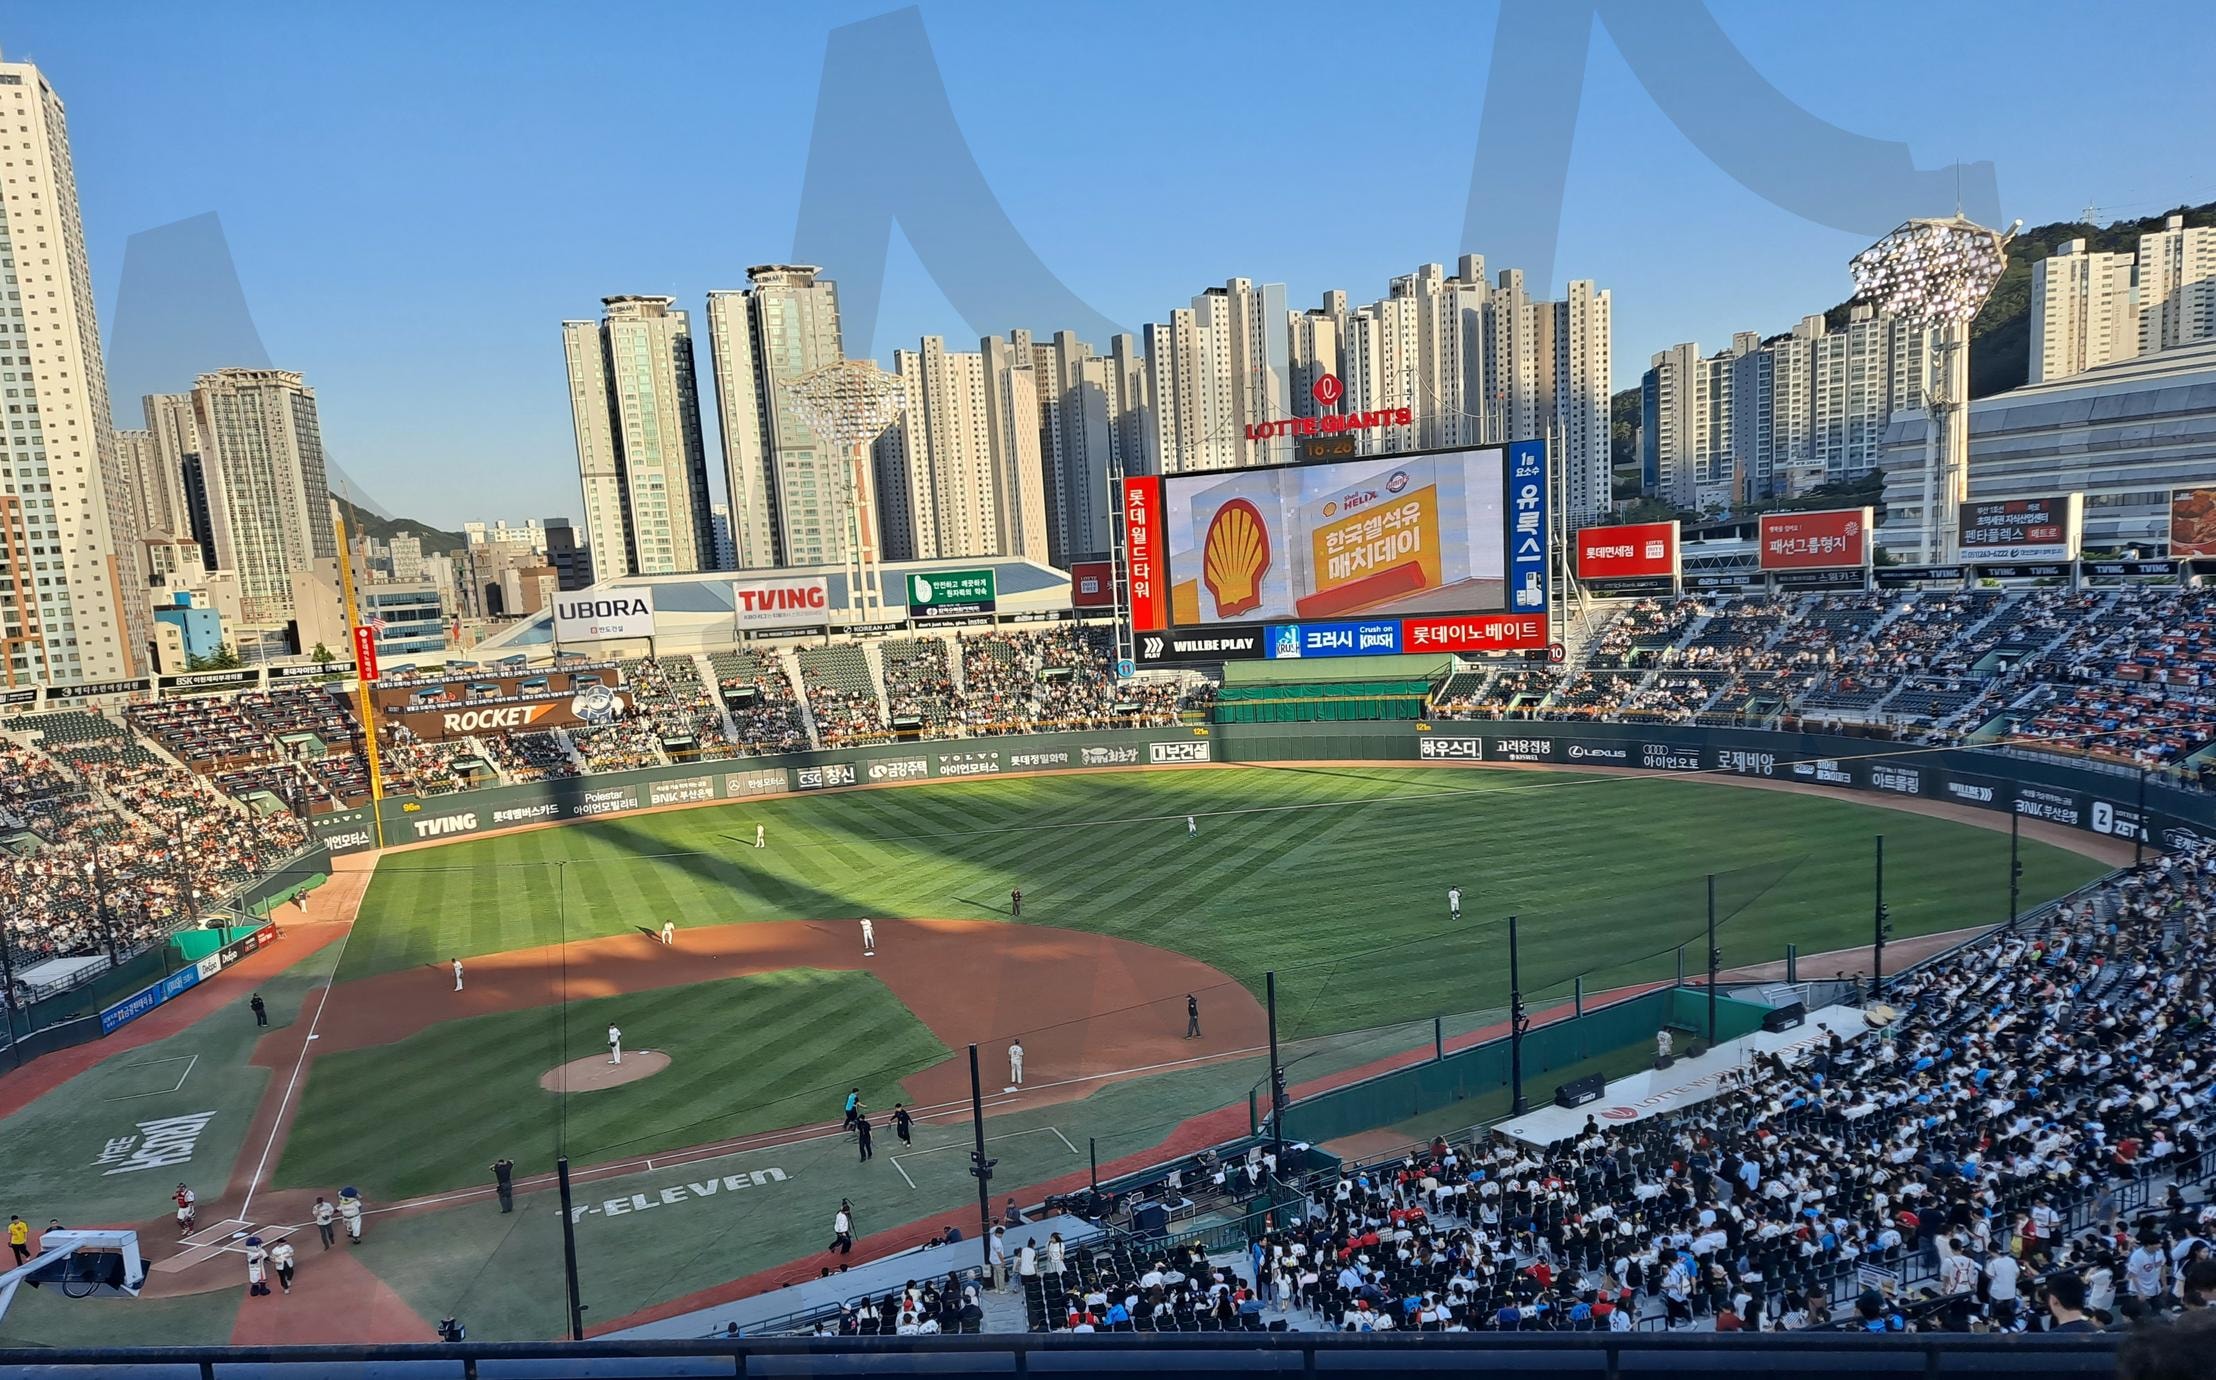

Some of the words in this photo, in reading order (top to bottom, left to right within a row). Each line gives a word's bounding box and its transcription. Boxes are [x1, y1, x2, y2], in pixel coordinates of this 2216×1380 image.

[1246, 416, 1317, 440] LOTTE
[1320, 407, 1412, 432] GIANTS
[1515, 466, 1540, 477] 요소수
[1344, 491, 1358, 501] Shell
[1344, 491, 1377, 511] HELIX
[1516, 484, 1541, 562] 유록스
[1965, 527, 2024, 543] 펜타플렉스
[1129, 489, 1150, 598] 롯데월드타워
[1769, 535, 1846, 555] 패션그룹형지
[1328, 526, 1420, 580] 매치데이
[1586, 545, 1634, 559] 롯데면세점
[1929, 569, 1960, 578] TVING
[1987, 567, 2016, 576] TVING
[2029, 566, 2059, 575] TVING
[2095, 565, 2125, 573] TVING
[2138, 564, 2169, 573] TVING
[738, 586, 825, 611] TVING
[558, 599, 649, 620] UBORA
[599, 625, 624, 633] 반도건설
[968, 618, 987, 626] instax
[1307, 630, 1352, 648] 크러시
[1360, 632, 1393, 649] KRUSH
[1413, 622, 1539, 644] 롯데이노베이트
[1173, 639, 1219, 653] WILLBE
[1222, 638, 1254, 650] PLAY
[1551, 647, 1563, 659] 10
[283, 665, 323, 676] 롯데자이언츠
[1121, 664, 1131, 673] 11
[176, 676, 193, 686] BSK
[443, 703, 538, 732] ROCKET
[1153, 743, 1209, 760] 대보건설
[1422, 740, 1477, 757] 하우스디
[1496, 740, 1551, 754] 고려용접봉
[1585, 750, 1626, 758] LEXUS
[939, 751, 999, 762] VOLVO
[1010, 751, 1069, 766] 롯데정밀화학
[1643, 756, 1699, 770] 아이언오토
[1717, 750, 1775, 776] 로제비앙
[827, 766, 856, 786] 창신
[887, 761, 928, 777] 금강주택
[939, 762, 1000, 776] 아이언모터스
[748, 777, 786, 789] 한성모터스
[800, 774, 823, 785] CSG
[1873, 773, 1919, 794] 아트몰링
[584, 790, 624, 803] Polestar
[651, 792, 679, 804] BNK
[680, 787, 714, 801] 부산은행
[403, 803, 421, 812] 96m
[492, 804, 560, 823] 롯데멤버스카드
[573, 797, 638, 816] 아이언모빌리티
[2016, 800, 2042, 816] BNK
[2043, 805, 2078, 825] 부산은행
[311, 813, 363, 827] VOLVO
[414, 813, 478, 837] TVING
[324, 830, 370, 851] 이언모터스
[1634, 1085, 1690, 1109] LOTTE
